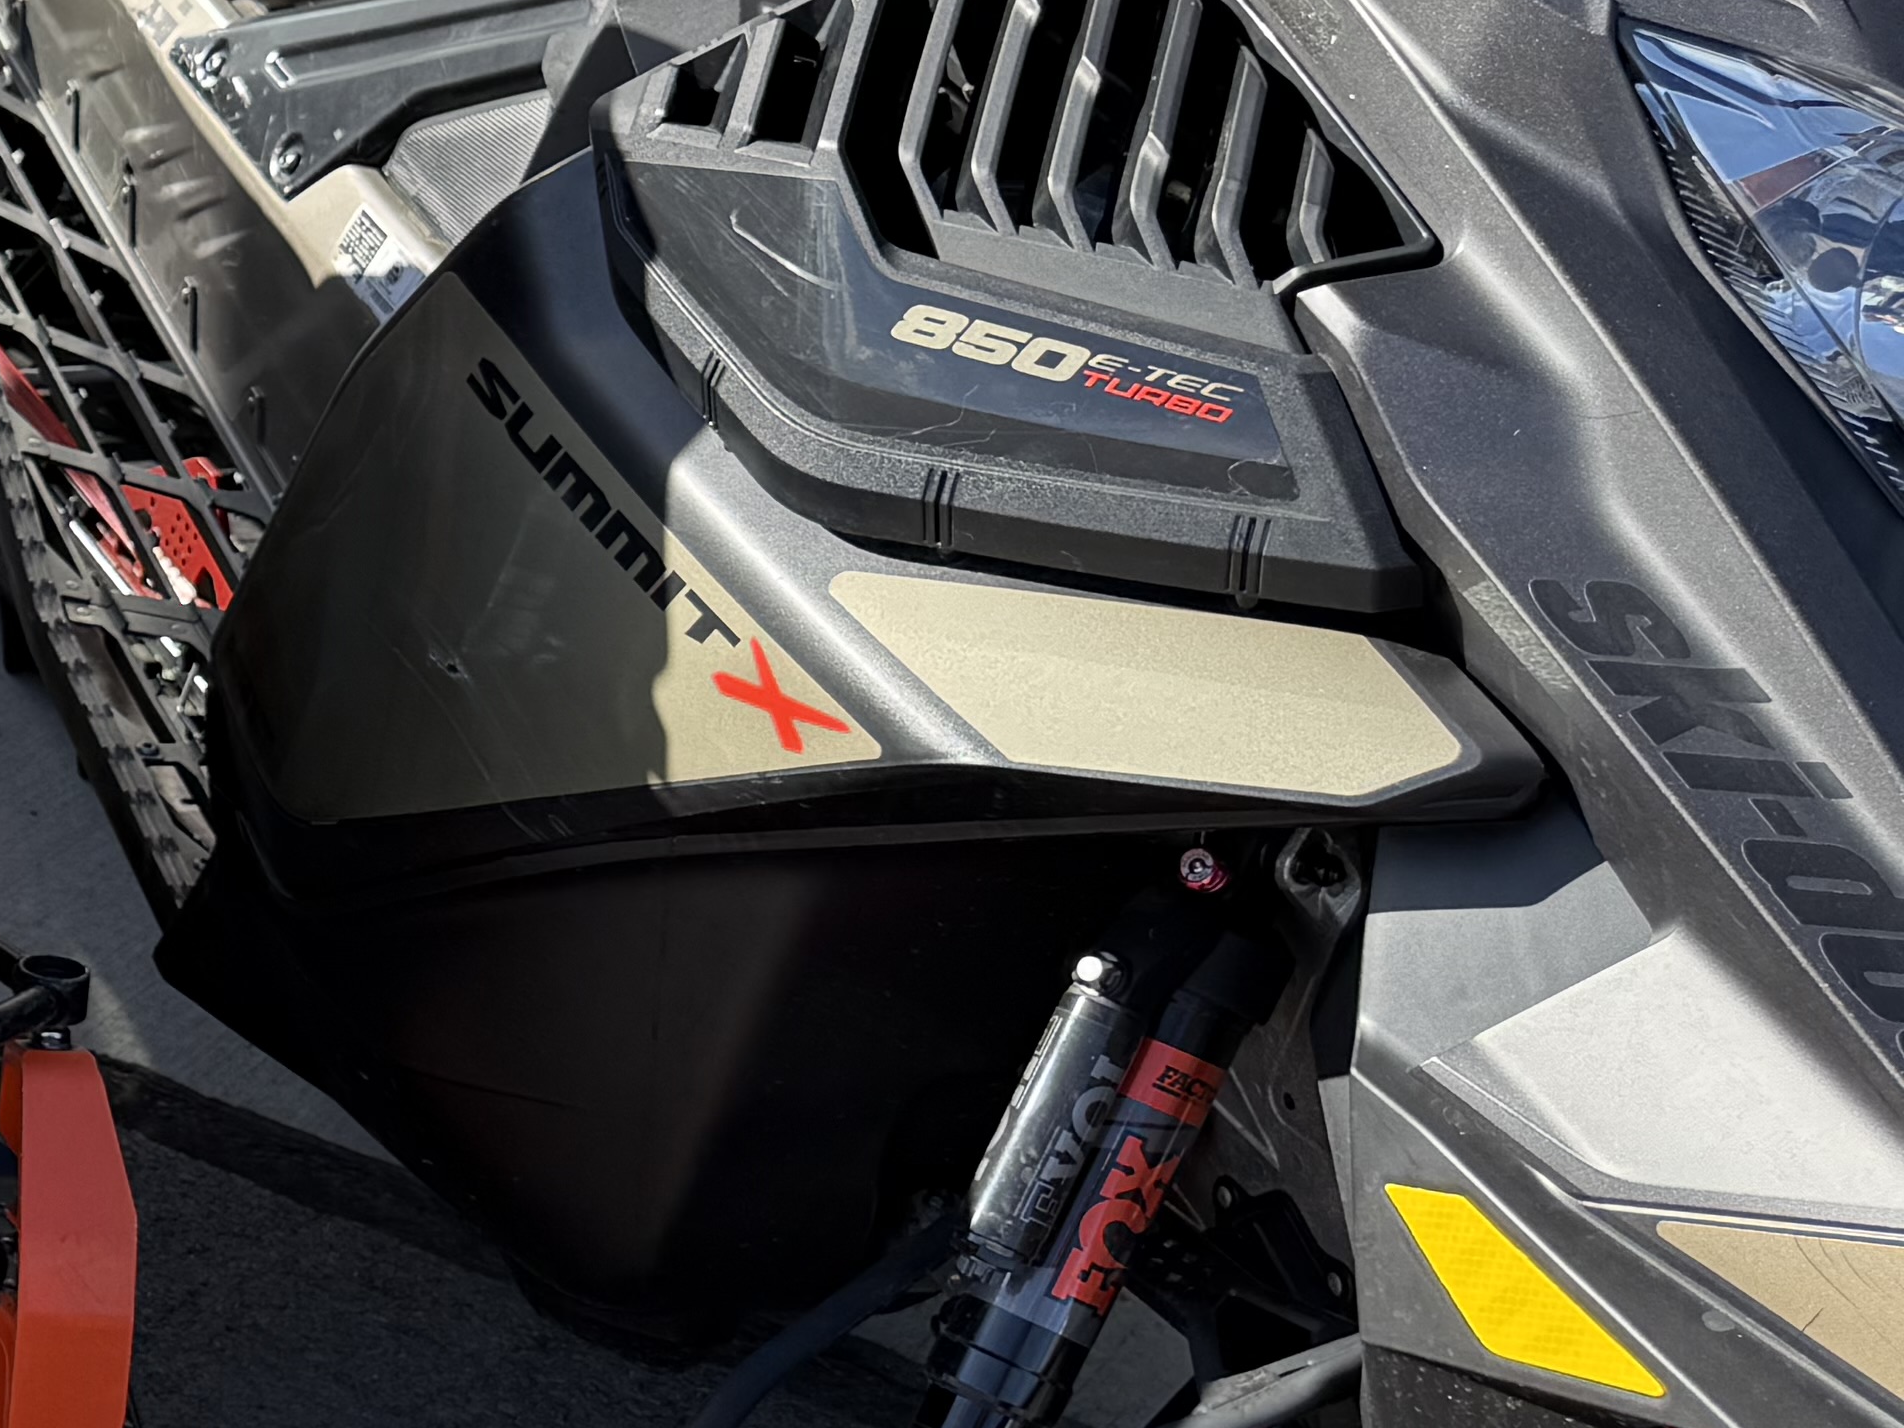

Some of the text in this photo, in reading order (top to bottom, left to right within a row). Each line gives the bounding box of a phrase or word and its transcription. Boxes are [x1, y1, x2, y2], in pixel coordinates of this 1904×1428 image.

[890, 303, 1245, 402] 850 E-TEC
[1083, 369, 1234, 423] TURBO
[466, 356, 852, 754] SUMMIT X
[1050, 1133, 1182, 1317] FOX
